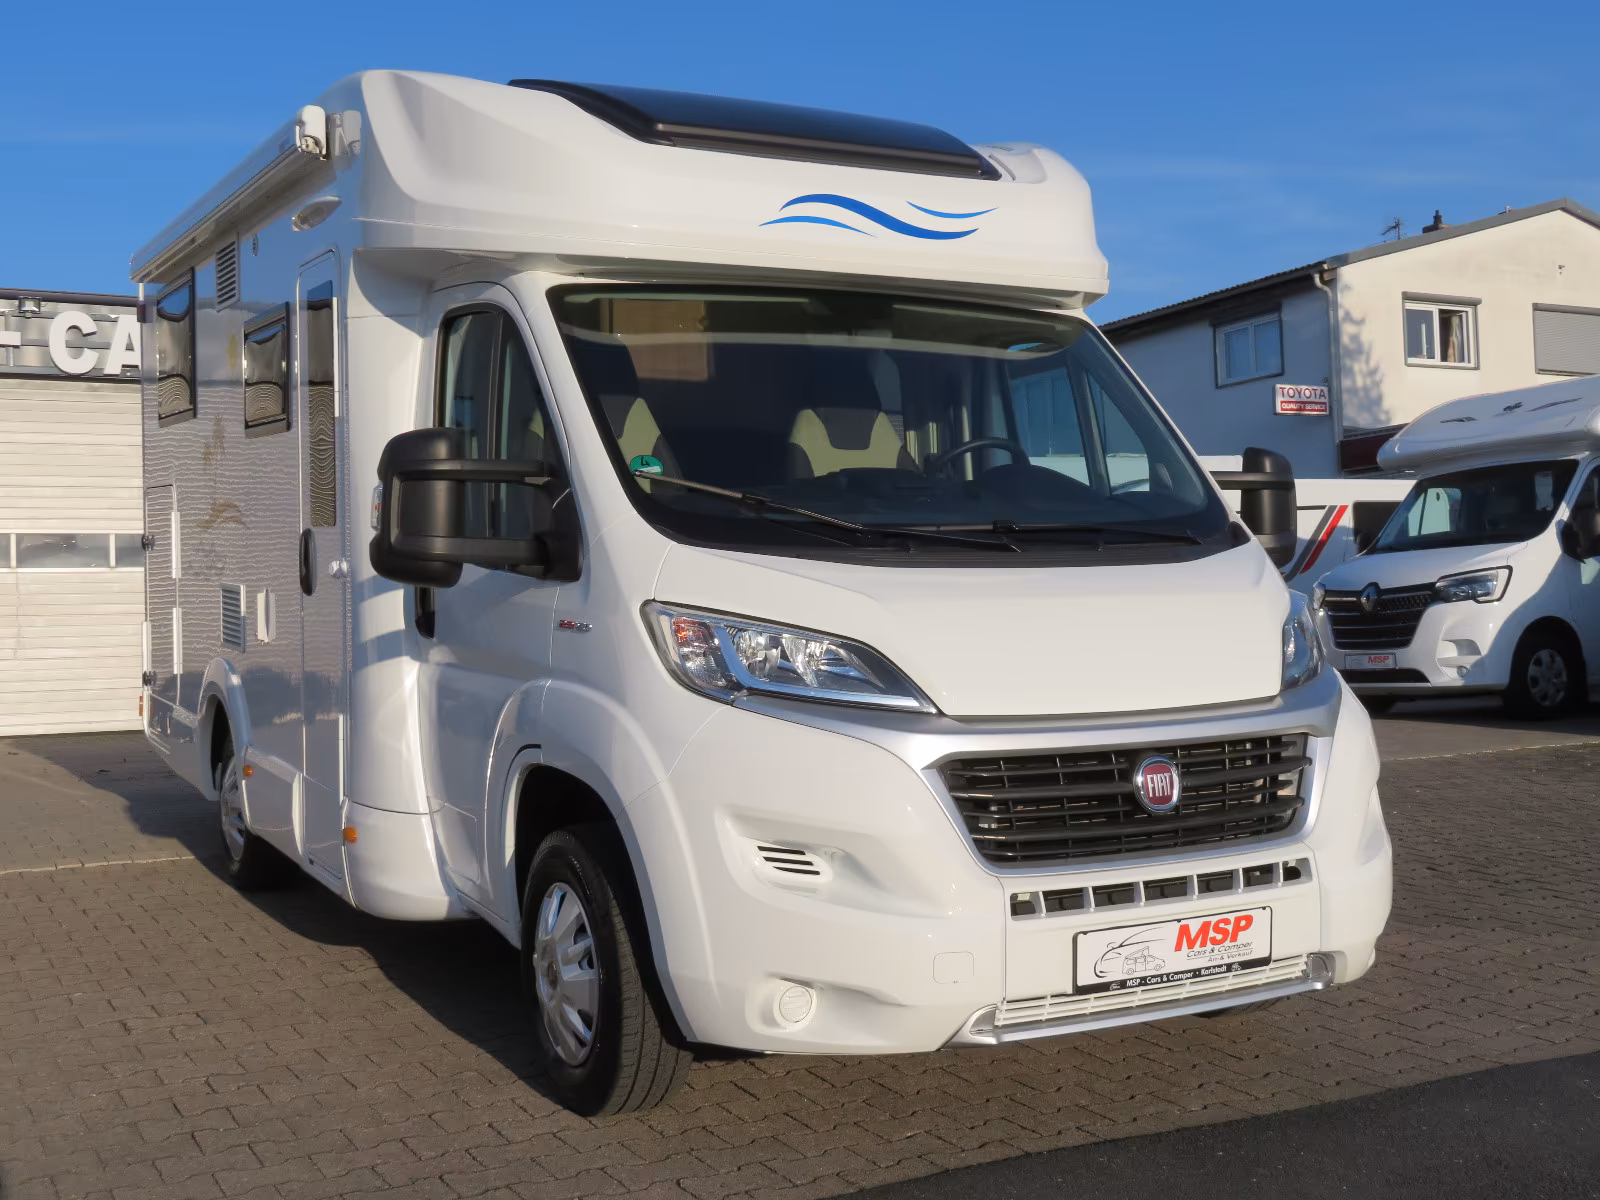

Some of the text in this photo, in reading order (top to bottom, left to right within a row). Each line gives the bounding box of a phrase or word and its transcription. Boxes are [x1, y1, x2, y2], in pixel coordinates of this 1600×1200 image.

[1279, 387, 1326, 399] TOYOTA
[1368, 656, 1389, 664] MSP
[1147, 773, 1171, 798] FIAT
[1175, 914, 1253, 952] MSP
[1187, 941, 1253, 958] Cars & Camper
[1227, 950, 1253, 959] Verkauf
[1127, 979, 1141, 987] MSP
[1147, 976, 1161, 984] Cars
[1169, 972, 1194, 980] Camper
[1201, 965, 1227, 975] Karlstadt
